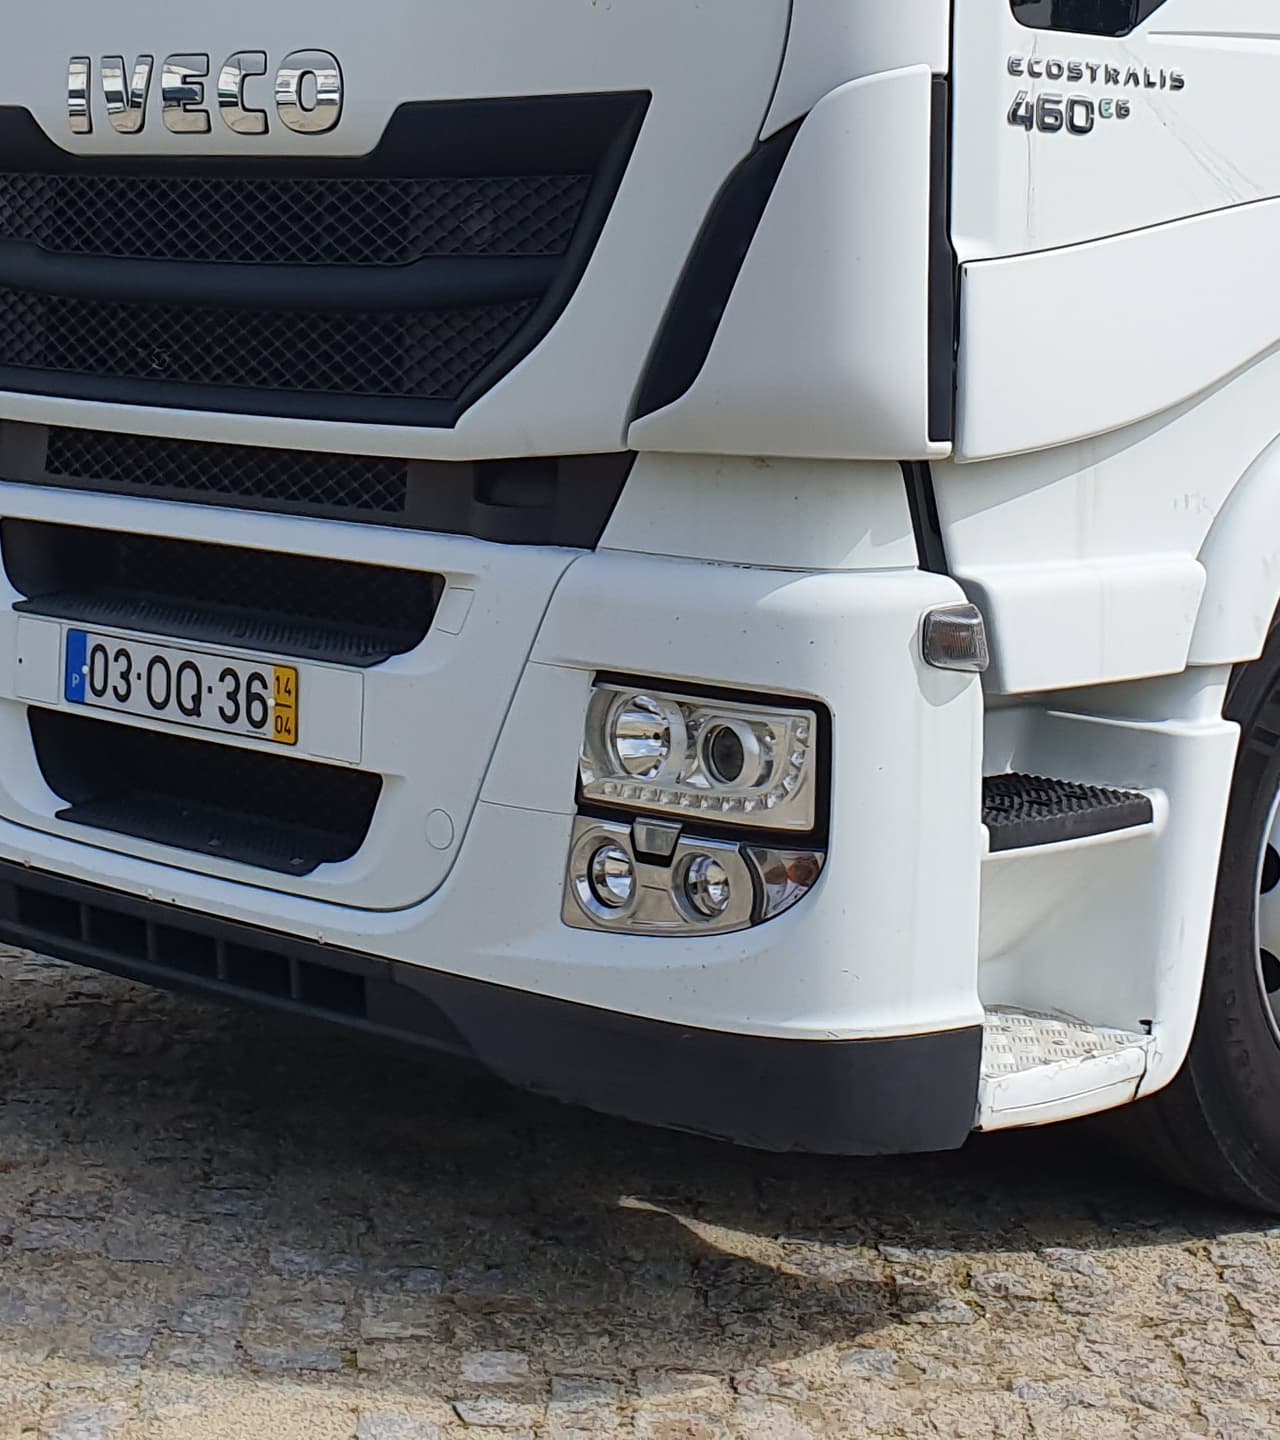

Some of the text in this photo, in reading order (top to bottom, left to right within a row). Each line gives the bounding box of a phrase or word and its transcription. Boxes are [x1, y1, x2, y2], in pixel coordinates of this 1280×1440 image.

[1006, 54, 1186, 91] ECOSTRALIS
[67, 47, 345, 136] IVECO
[71, 673, 81, 688] P
[274, 675, 292, 696] 14
[274, 714, 292, 736] 04
